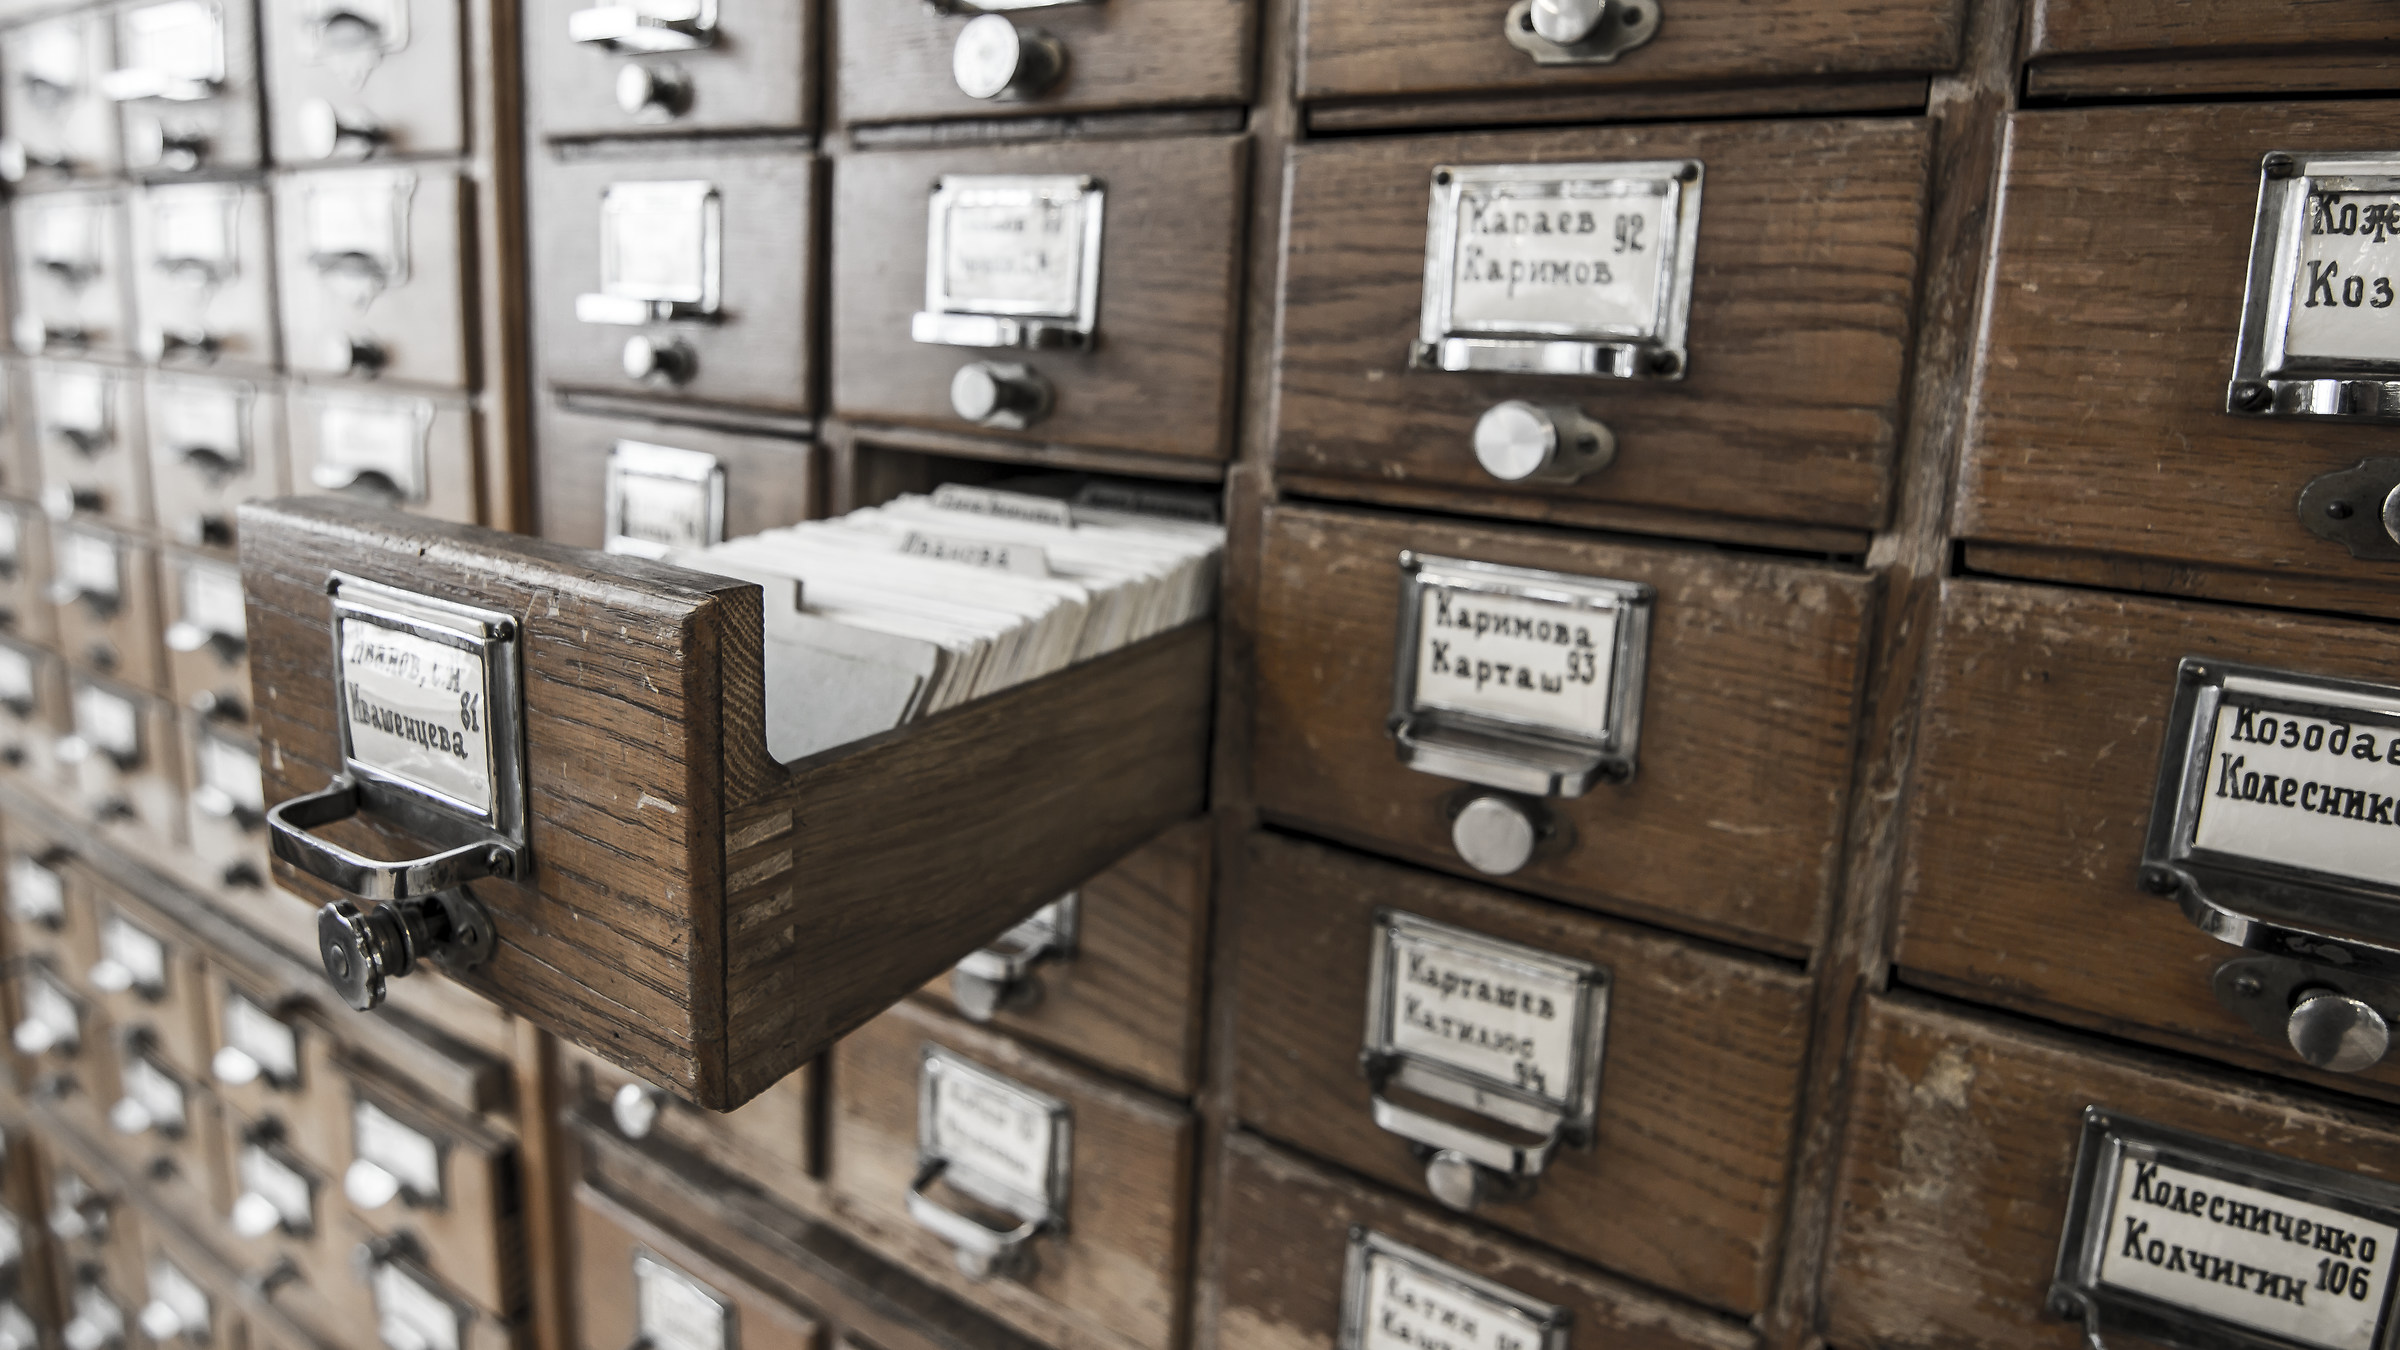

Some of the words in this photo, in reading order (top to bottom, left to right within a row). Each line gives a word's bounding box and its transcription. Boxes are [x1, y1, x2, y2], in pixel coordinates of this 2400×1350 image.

[1462, 194, 1596, 235] Караев
[1613, 212, 1646, 254] 92
[1462, 245, 1614, 299] Каримов
[1434, 590, 1594, 649] Каримова
[1430, 639, 1562, 693] Карташ
[1566, 651, 1598, 686] 93
[349, 682, 468, 760] Ивашенцева
[460, 691, 479, 732] 81
[2132, 1161, 2377, 1263] Колесниченко
[2121, 1216, 2307, 1305] Колчигин
[2314, 1257, 2370, 1301] 106
